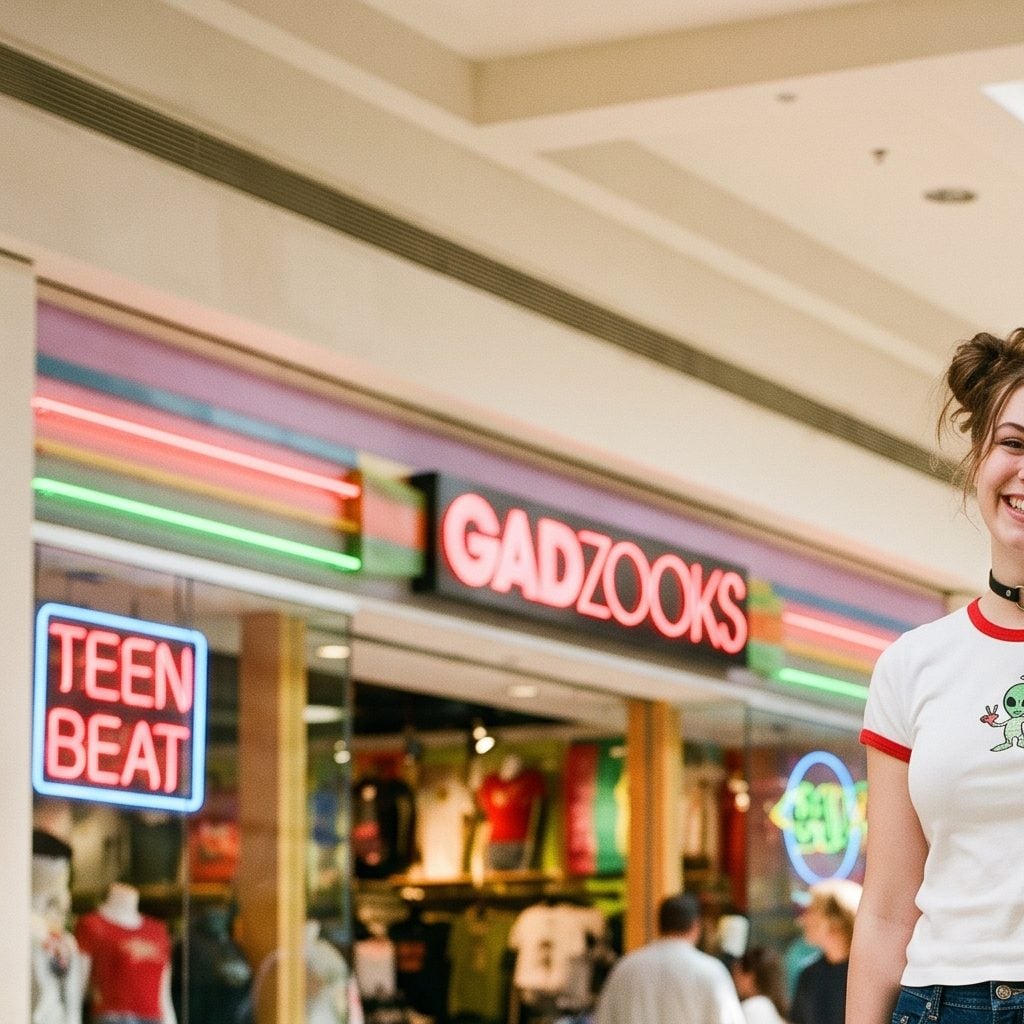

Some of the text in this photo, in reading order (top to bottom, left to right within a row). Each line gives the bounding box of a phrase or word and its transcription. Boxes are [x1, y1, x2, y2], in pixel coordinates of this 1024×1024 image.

[442, 492, 748, 654] GADZOOKS
[49, 622, 193, 714] TEEN
[47, 707, 190, 793] BEAT
